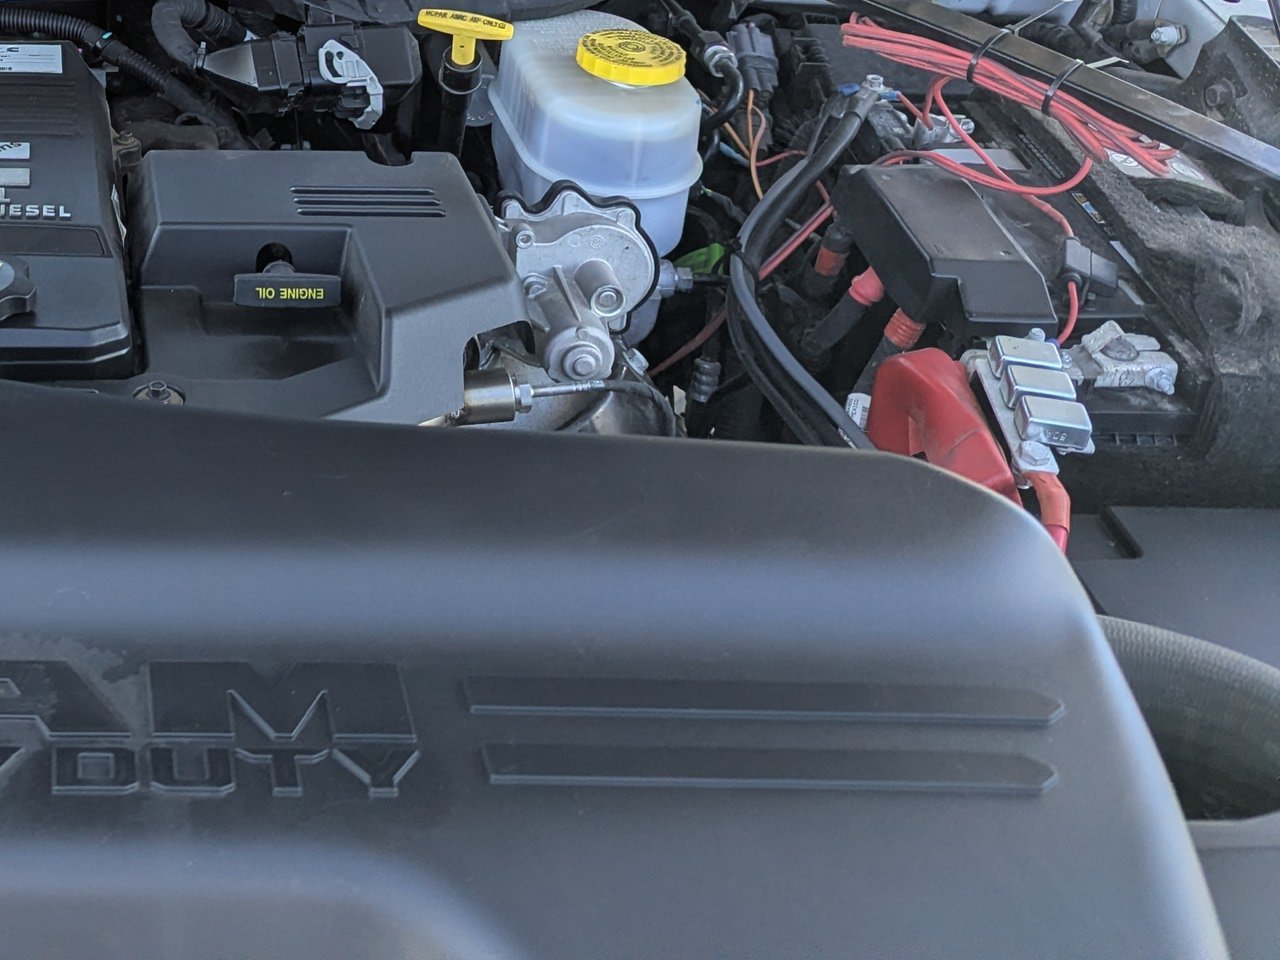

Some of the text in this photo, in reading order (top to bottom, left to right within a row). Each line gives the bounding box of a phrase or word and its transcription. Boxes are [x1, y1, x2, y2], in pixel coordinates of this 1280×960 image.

[255, 287, 324, 300] ENGINE OIL
[51, 744, 421, 798] DUTY
